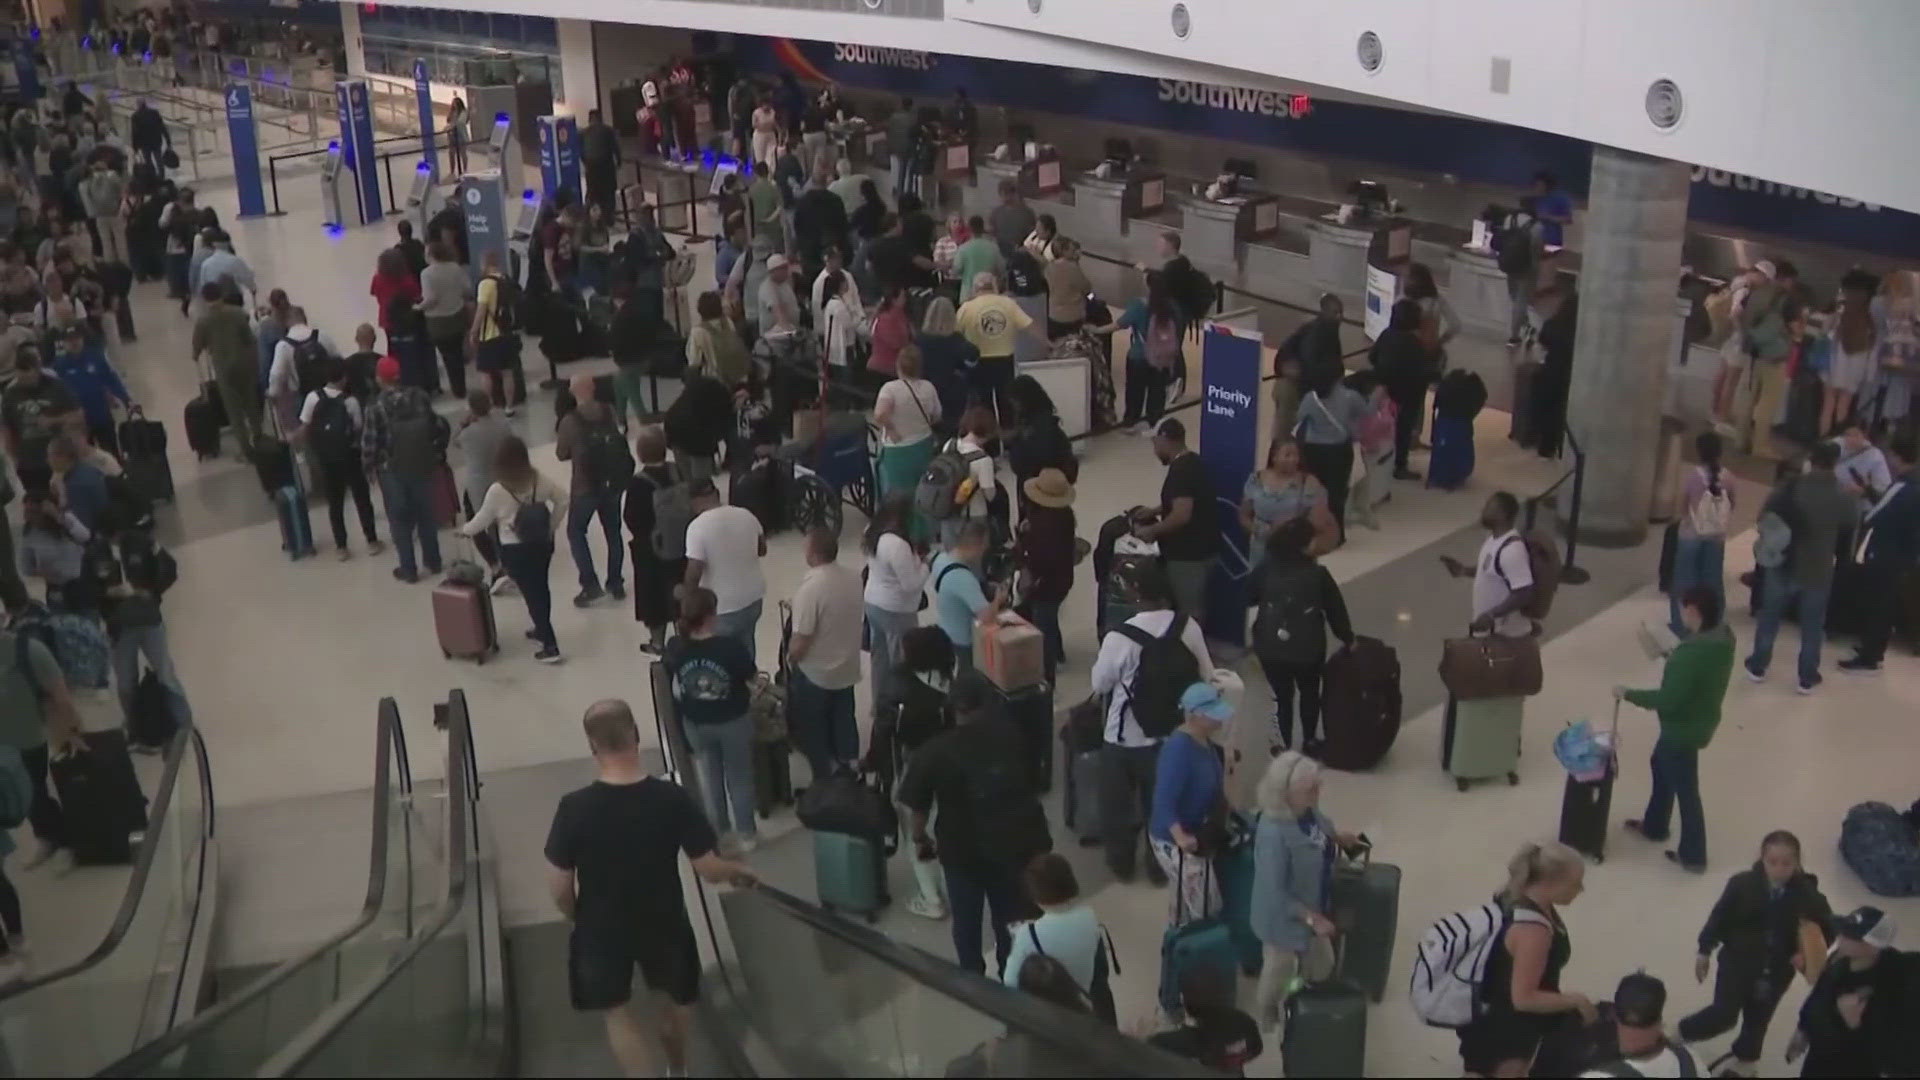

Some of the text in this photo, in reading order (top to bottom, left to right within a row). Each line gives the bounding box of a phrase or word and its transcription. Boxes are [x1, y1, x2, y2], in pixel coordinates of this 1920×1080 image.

[834, 42, 929, 70] Southwest
[1208, 385, 1251, 408] Priority
[1208, 400, 1235, 418] Lane
